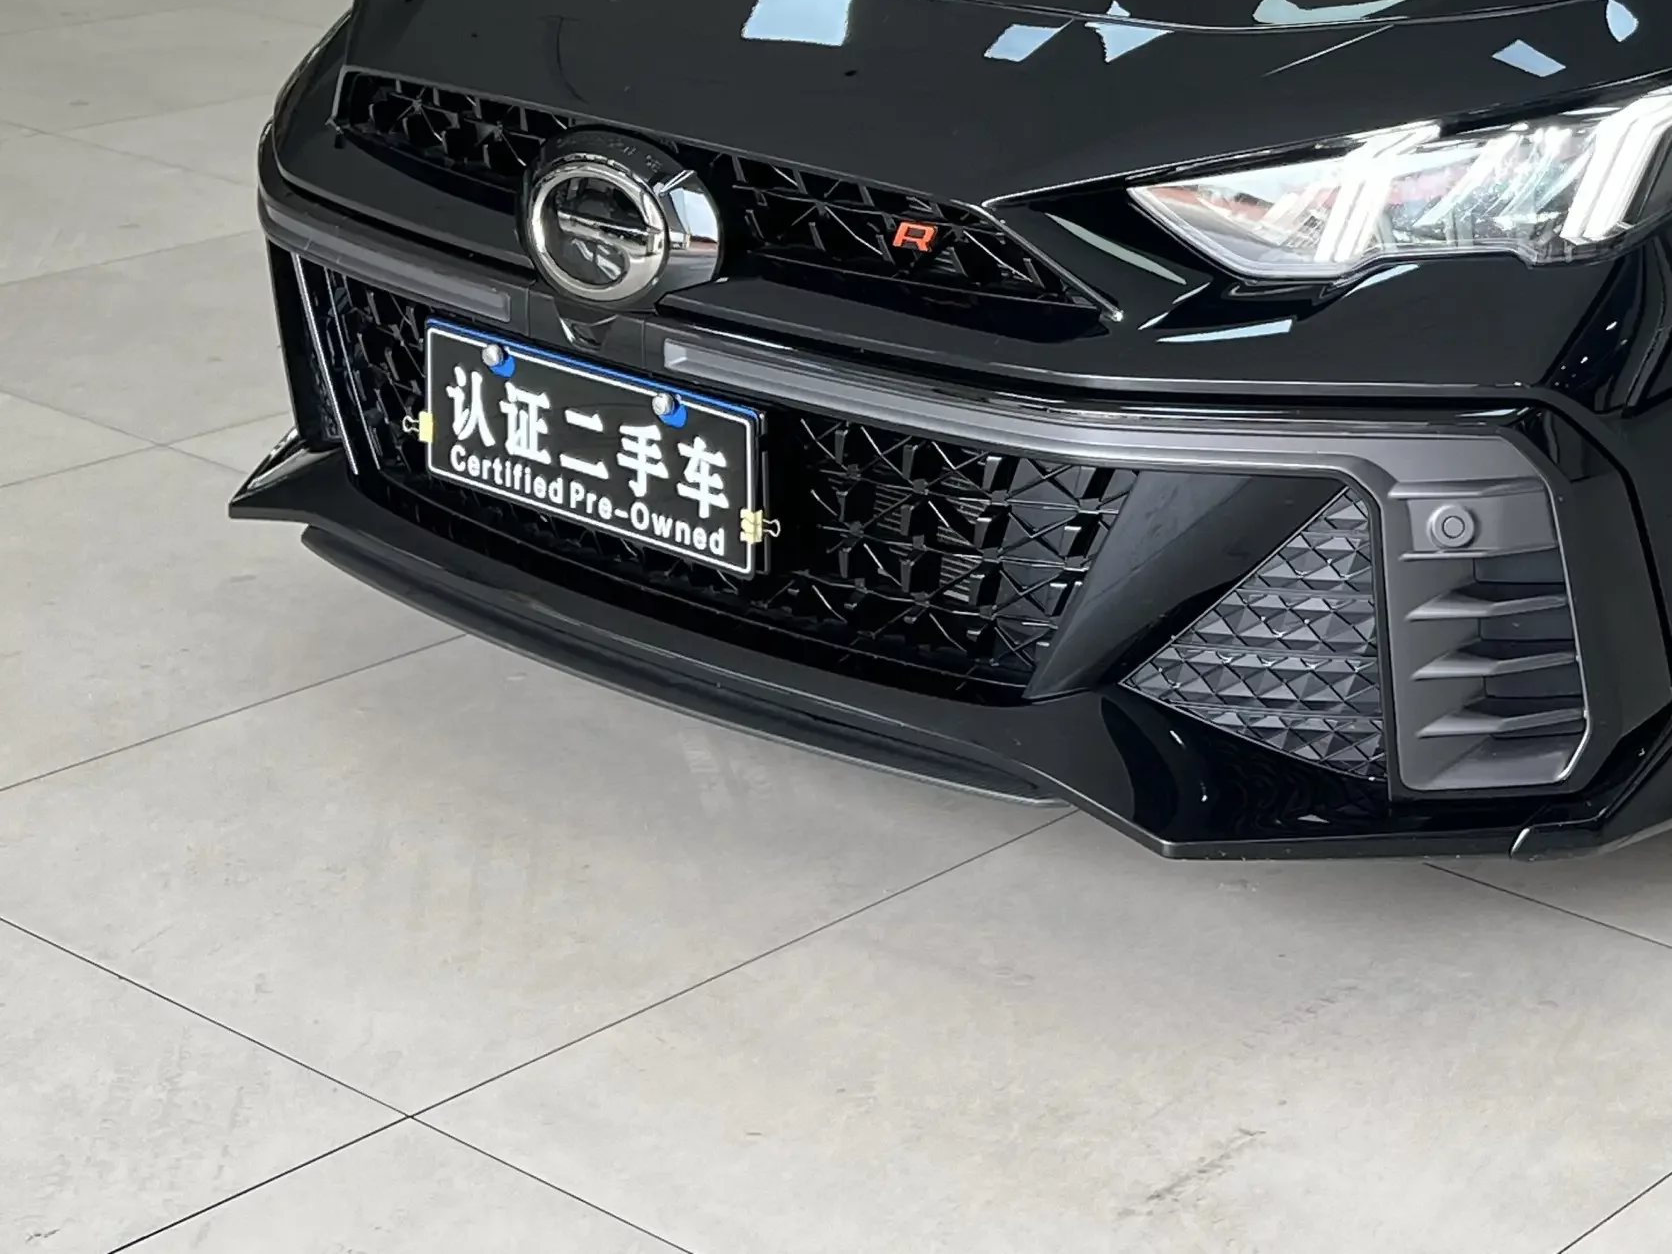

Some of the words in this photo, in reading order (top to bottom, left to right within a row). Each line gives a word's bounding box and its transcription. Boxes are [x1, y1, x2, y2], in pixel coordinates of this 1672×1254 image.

[892, 221, 938, 253] R
[445, 365, 731, 520] 认证二手车
[449, 444, 564, 506] Certified
[569, 478, 726, 557] Pre-Owned
